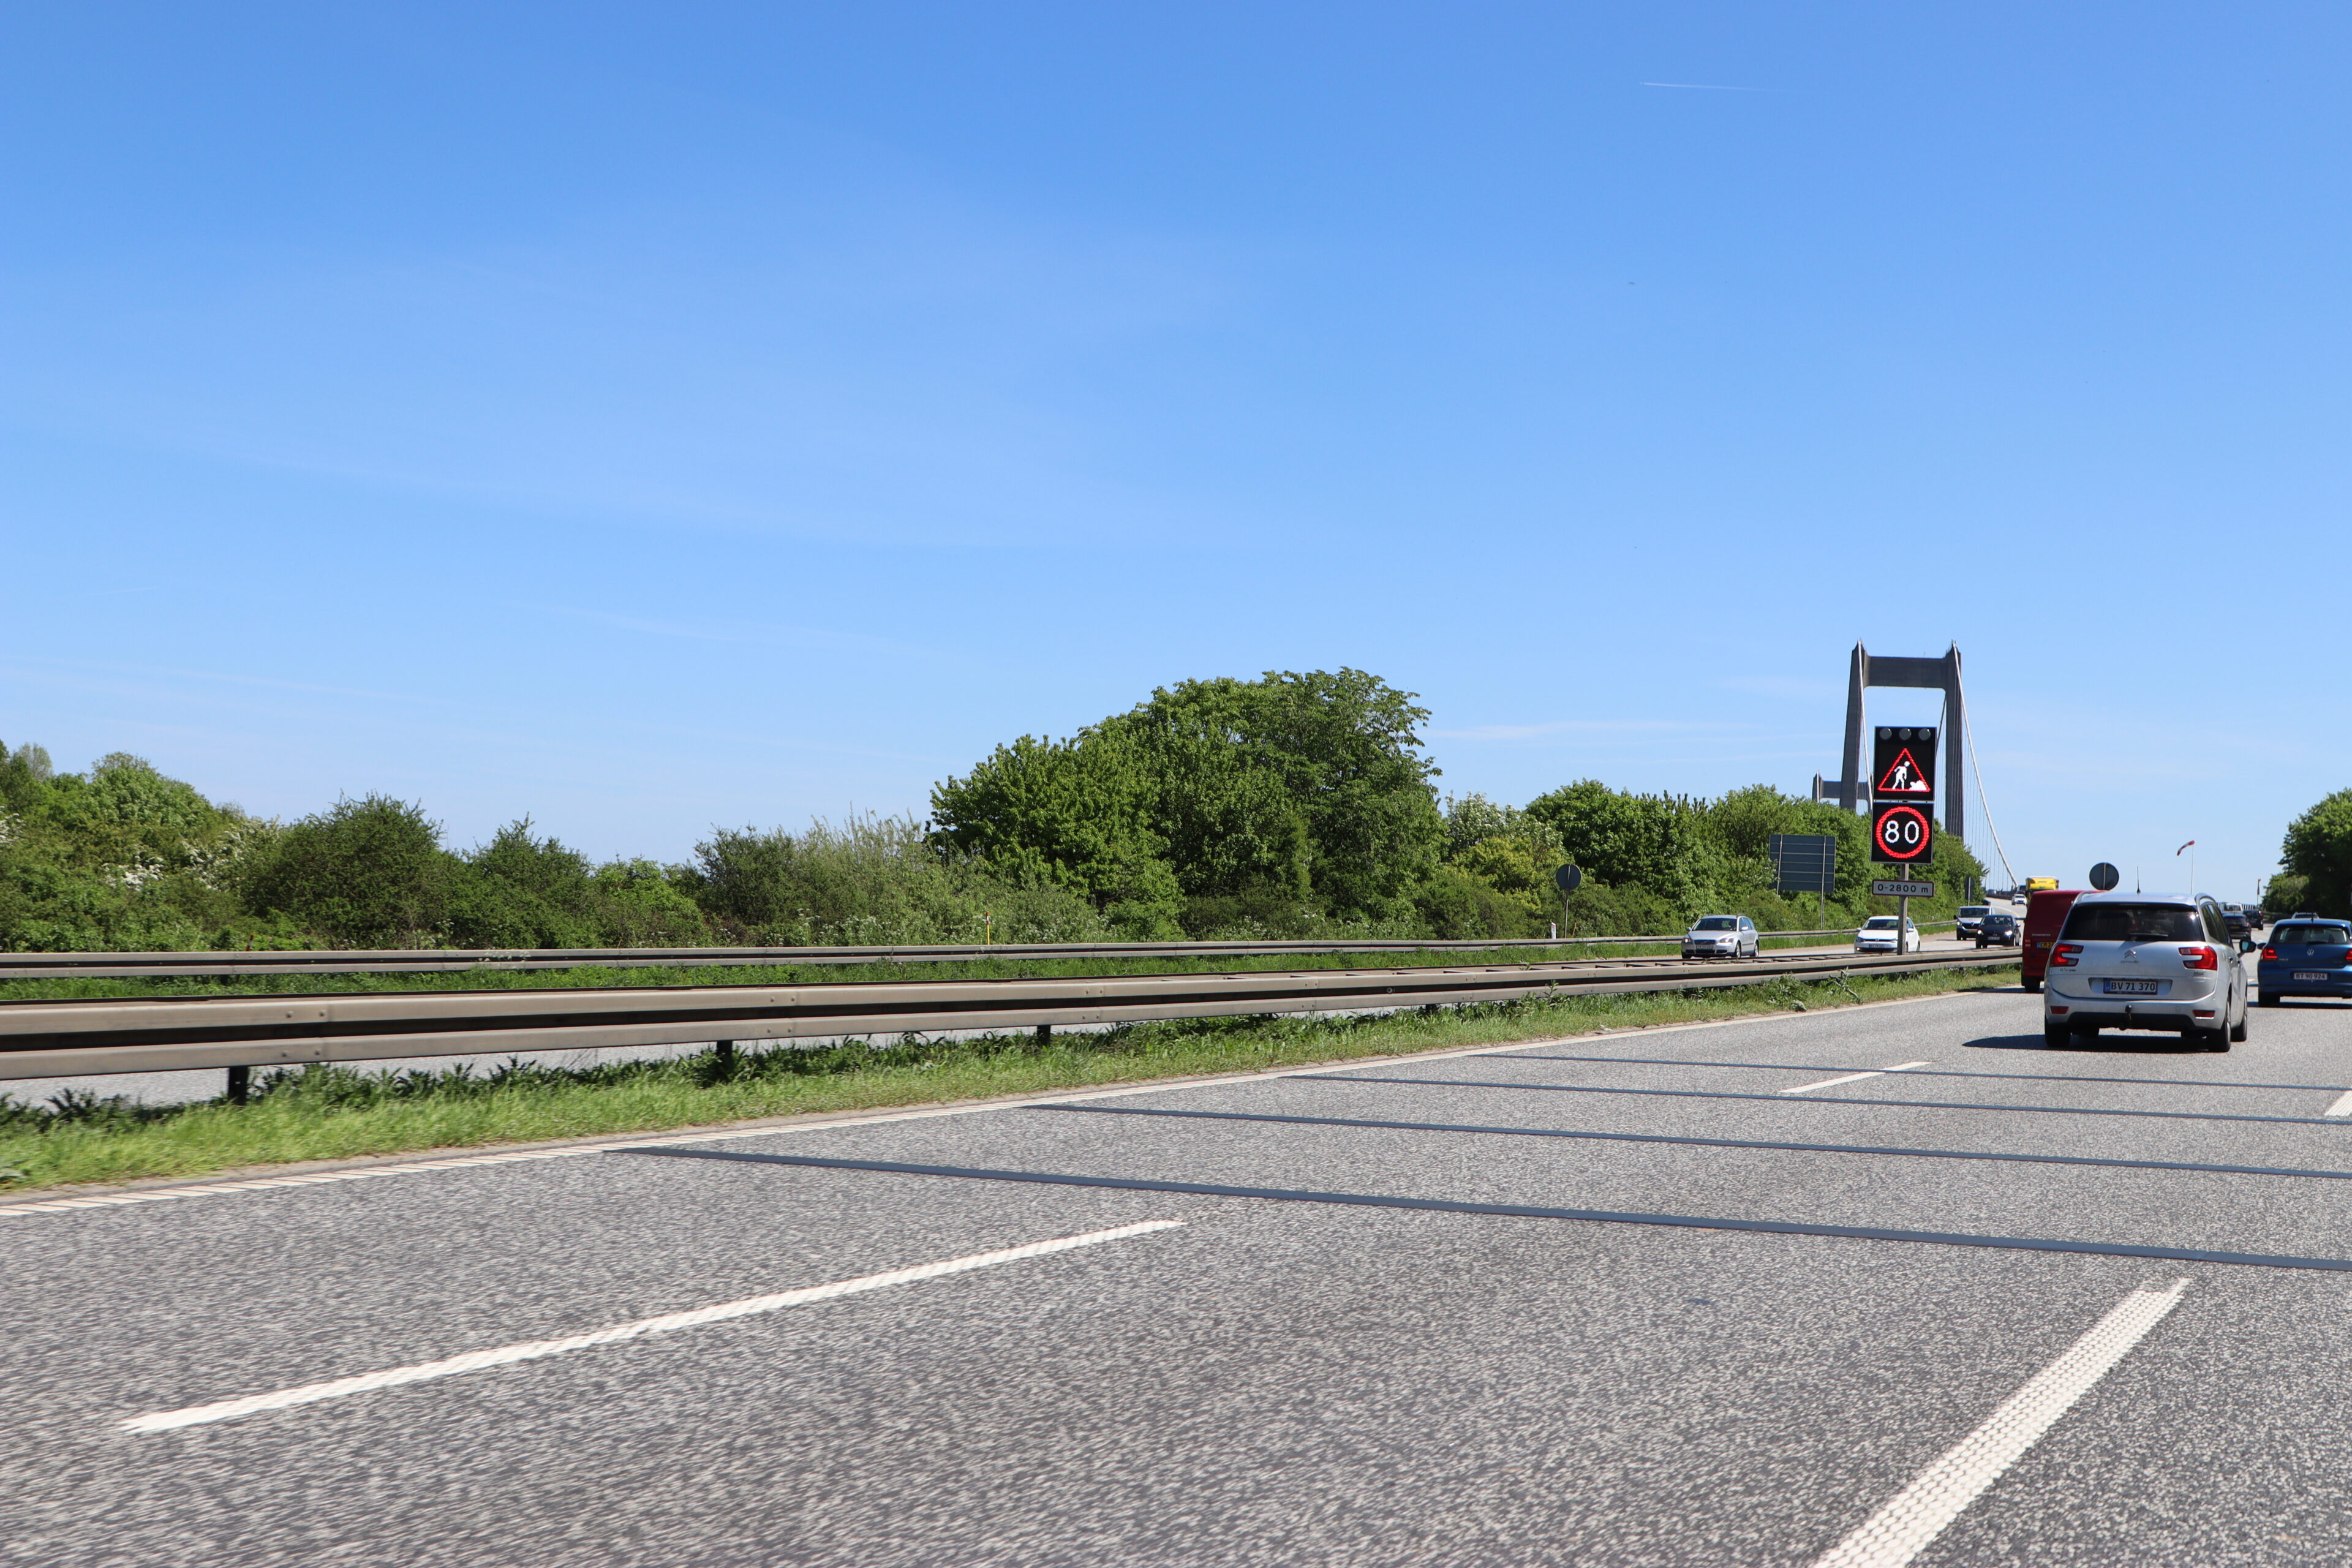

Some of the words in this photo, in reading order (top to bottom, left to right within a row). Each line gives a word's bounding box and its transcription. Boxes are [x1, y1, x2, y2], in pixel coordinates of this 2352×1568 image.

[1885, 820, 1920, 844] 80
[1877, 883, 1917, 892] 0-2800
[2111, 982, 2124, 990] BV
[2138, 982, 2155, 991] 370
